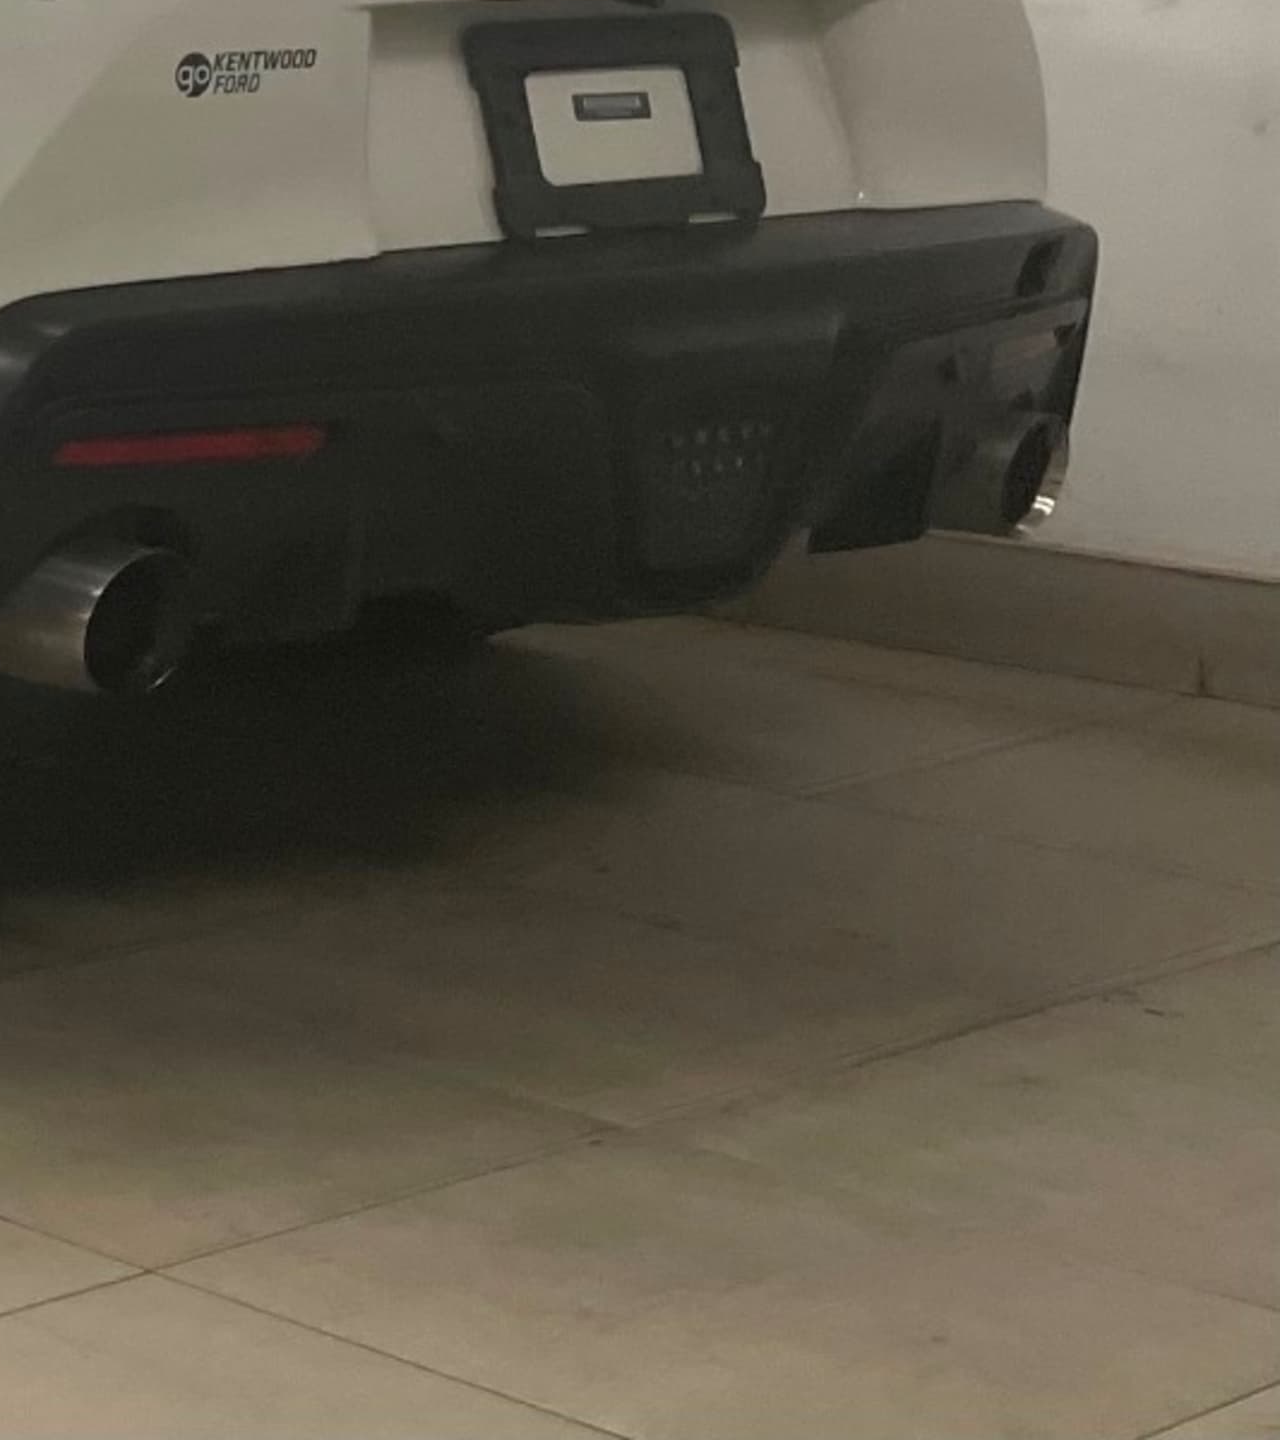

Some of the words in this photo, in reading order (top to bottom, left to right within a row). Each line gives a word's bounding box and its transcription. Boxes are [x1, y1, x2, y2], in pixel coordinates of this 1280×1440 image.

[212, 48, 317, 73] KENTWOOD
[178, 62, 211, 97] go
[212, 73, 261, 95] FORD
